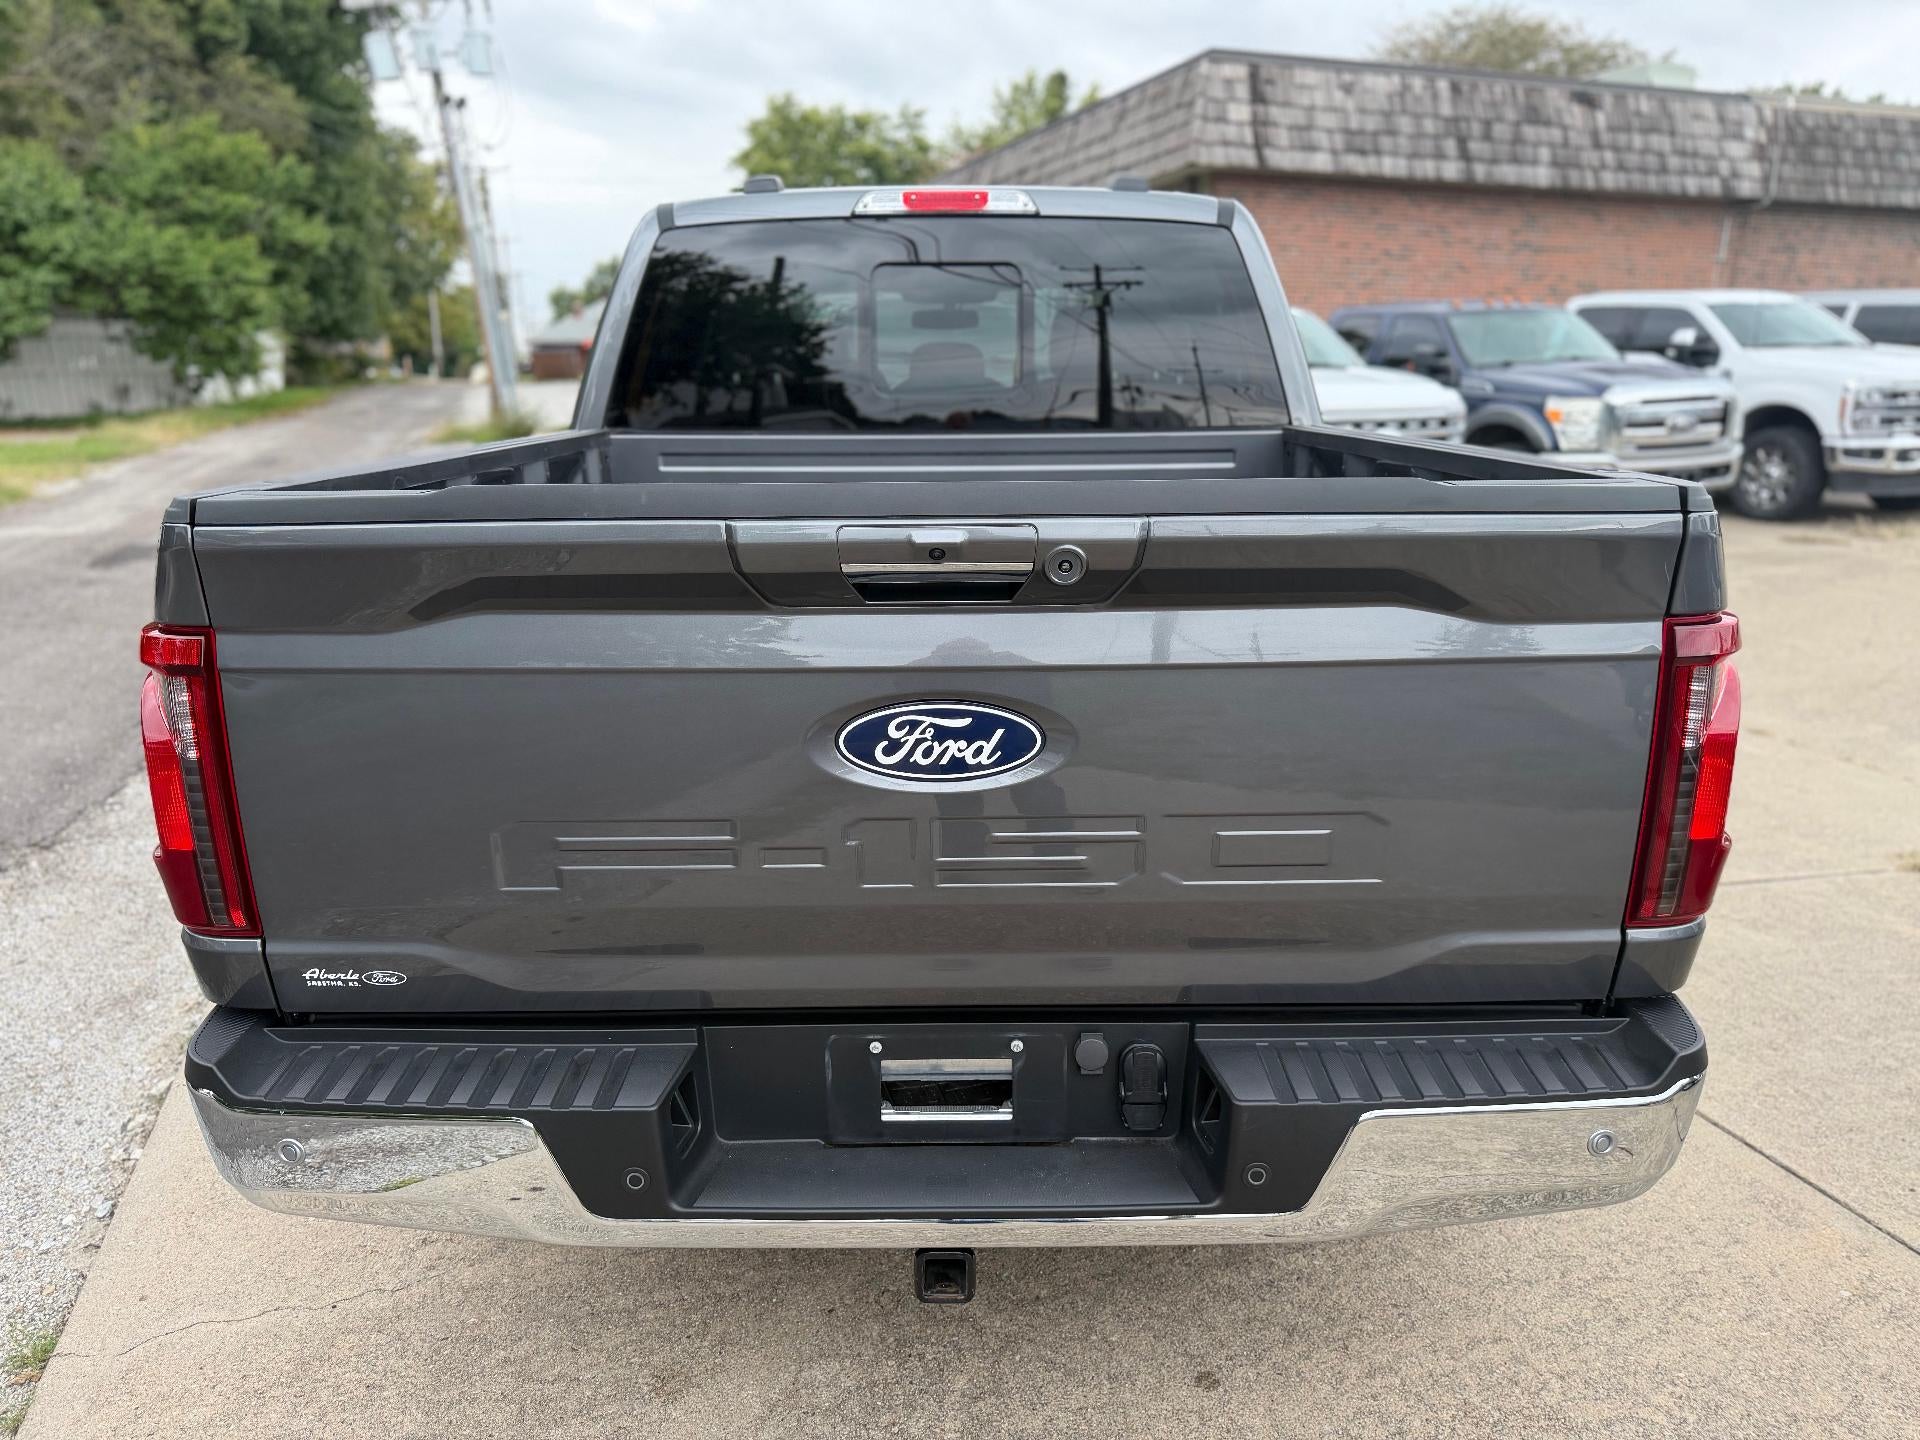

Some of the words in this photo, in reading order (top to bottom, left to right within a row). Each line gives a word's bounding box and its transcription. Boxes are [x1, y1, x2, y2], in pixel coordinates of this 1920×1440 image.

[874, 714, 1006, 766] Ford
[490, 812, 1390, 892] F-150
[301, 967, 360, 980] Aberle
[371, 972, 399, 983] Ford
